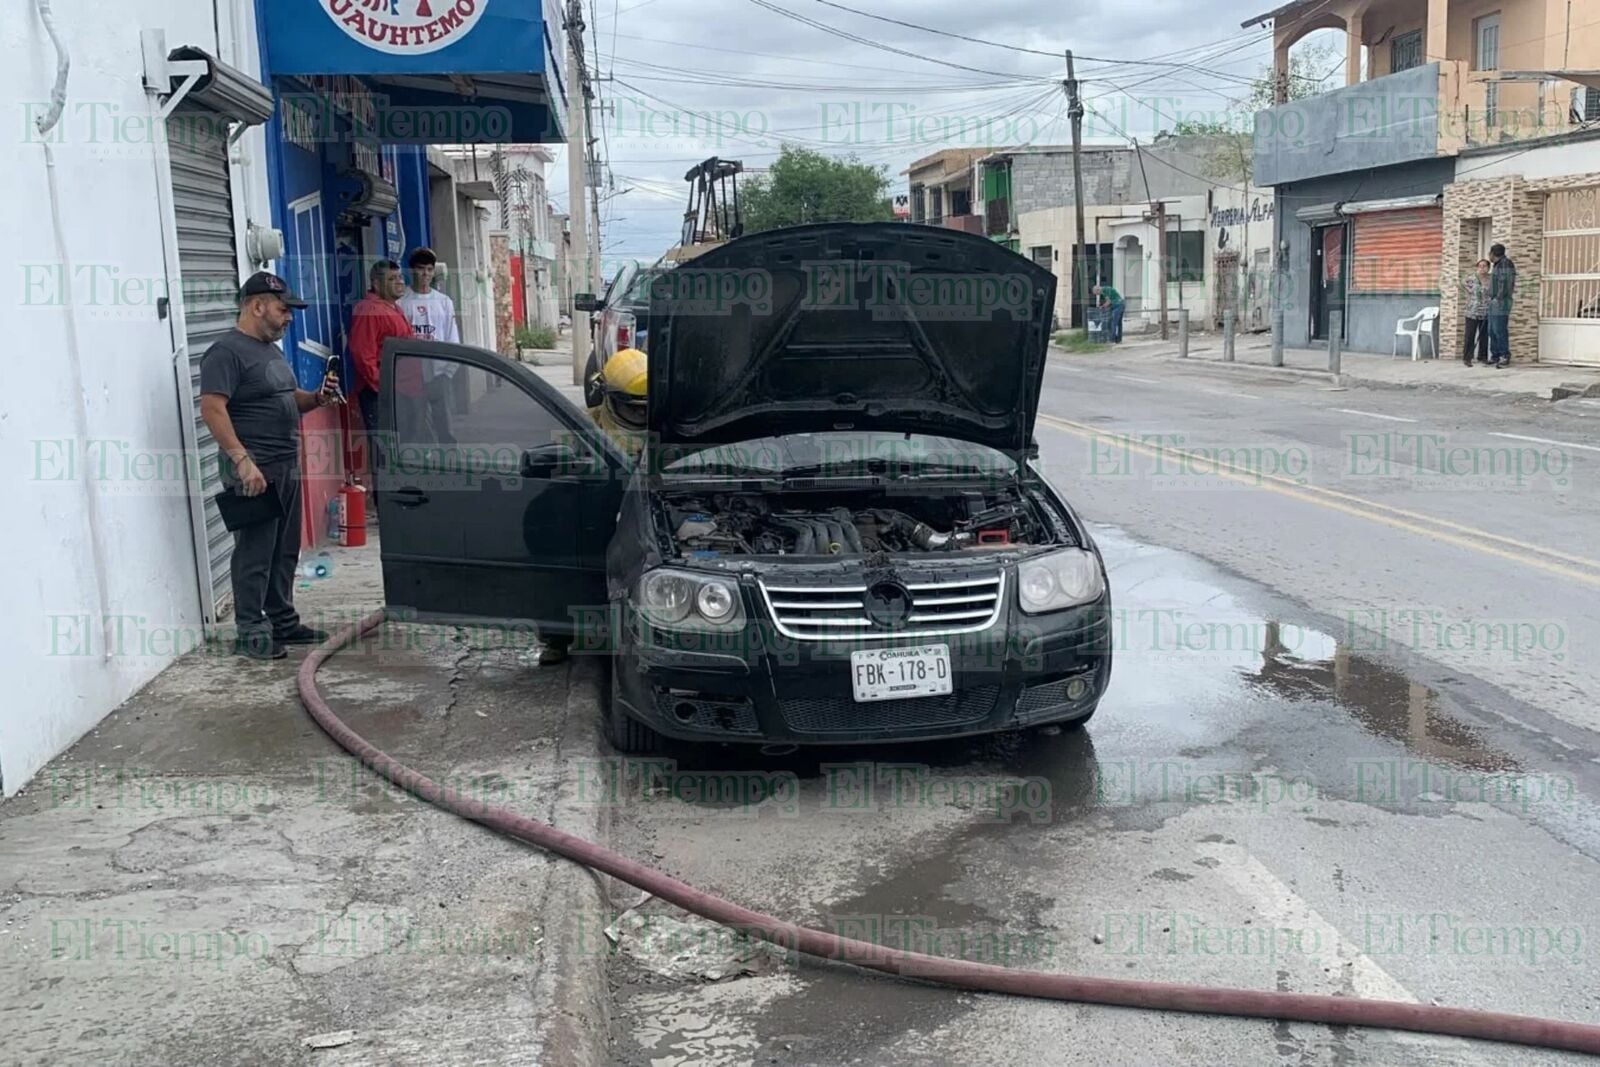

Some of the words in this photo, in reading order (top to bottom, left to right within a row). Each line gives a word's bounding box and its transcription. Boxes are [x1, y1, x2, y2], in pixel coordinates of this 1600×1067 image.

[1211, 205, 1245, 228] HERRERIA
[879, 650, 920, 661] COAHUILA
[856, 657, 947, 687] FBK-178-D
